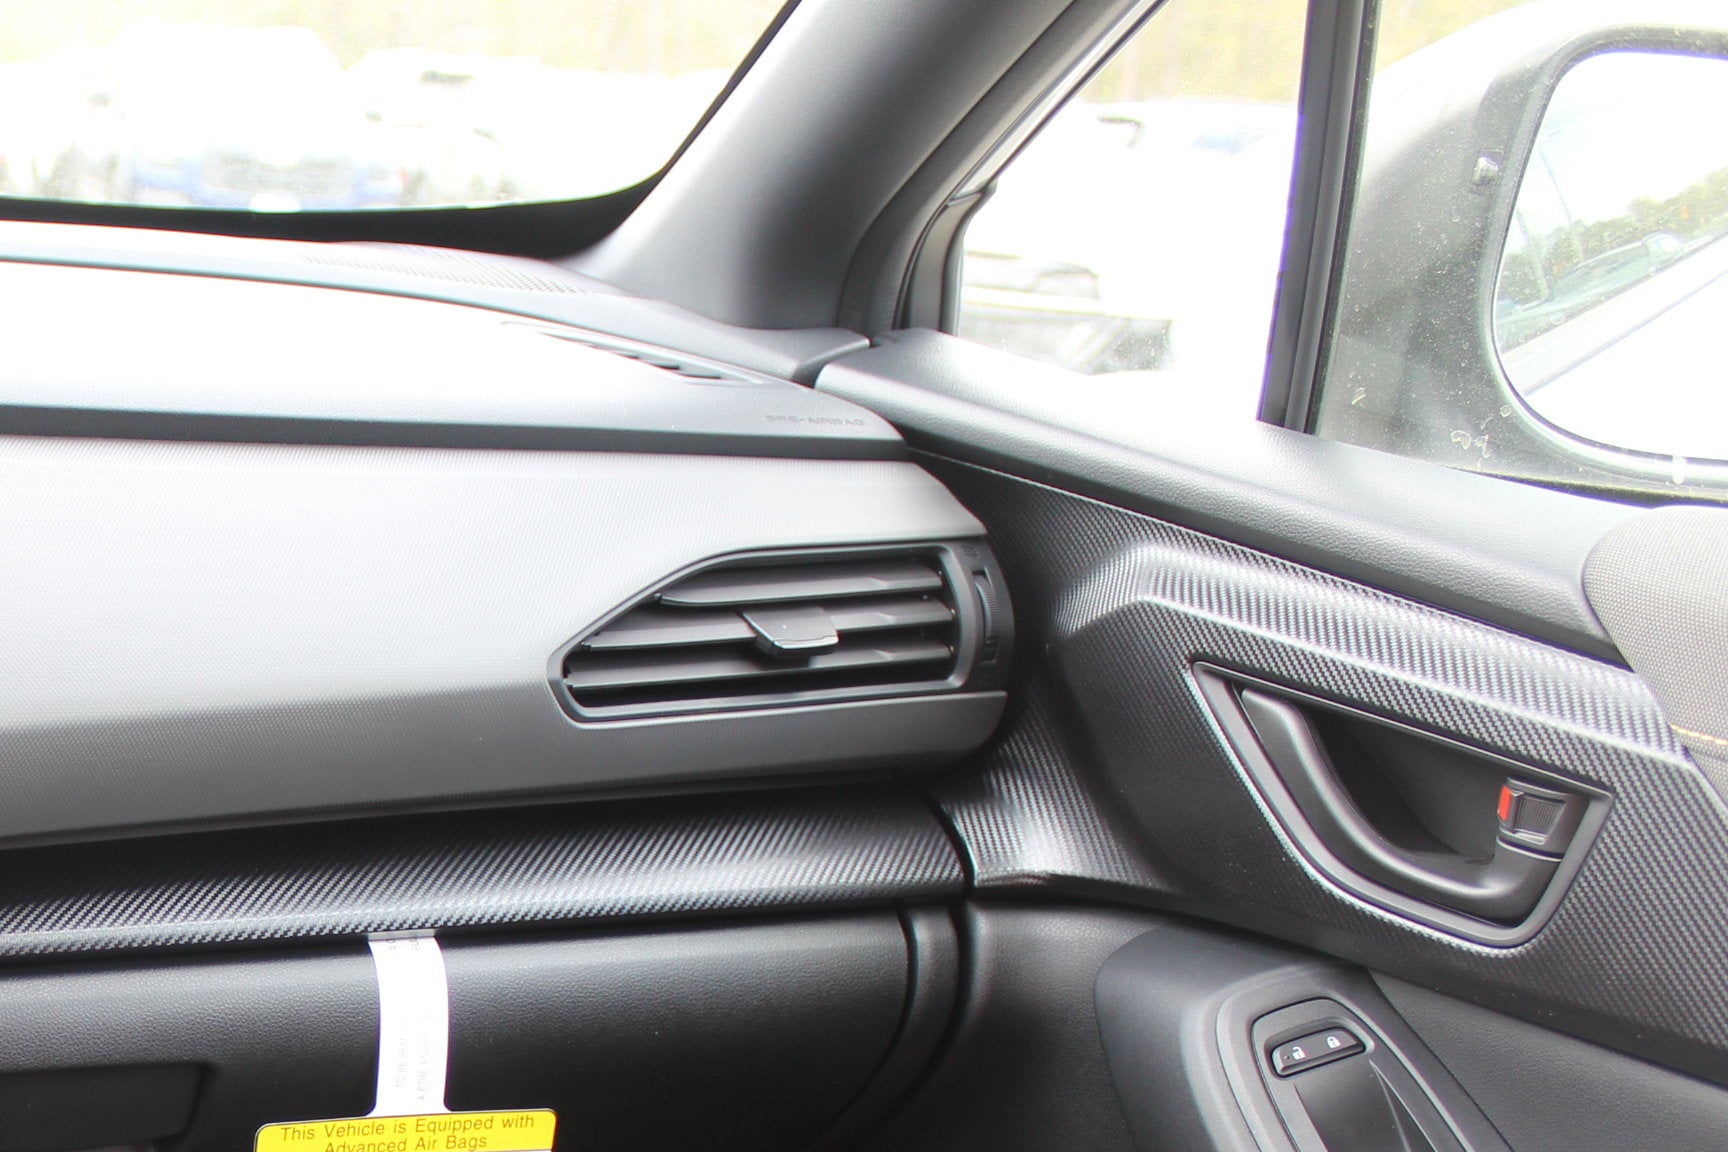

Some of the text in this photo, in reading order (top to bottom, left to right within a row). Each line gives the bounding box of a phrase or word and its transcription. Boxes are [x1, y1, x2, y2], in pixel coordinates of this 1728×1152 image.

[281, 1115, 534, 1141] This Vehicle is Equipped with
[415, 1137, 437, 1151] Air
[446, 1134, 487, 1152] Bags
